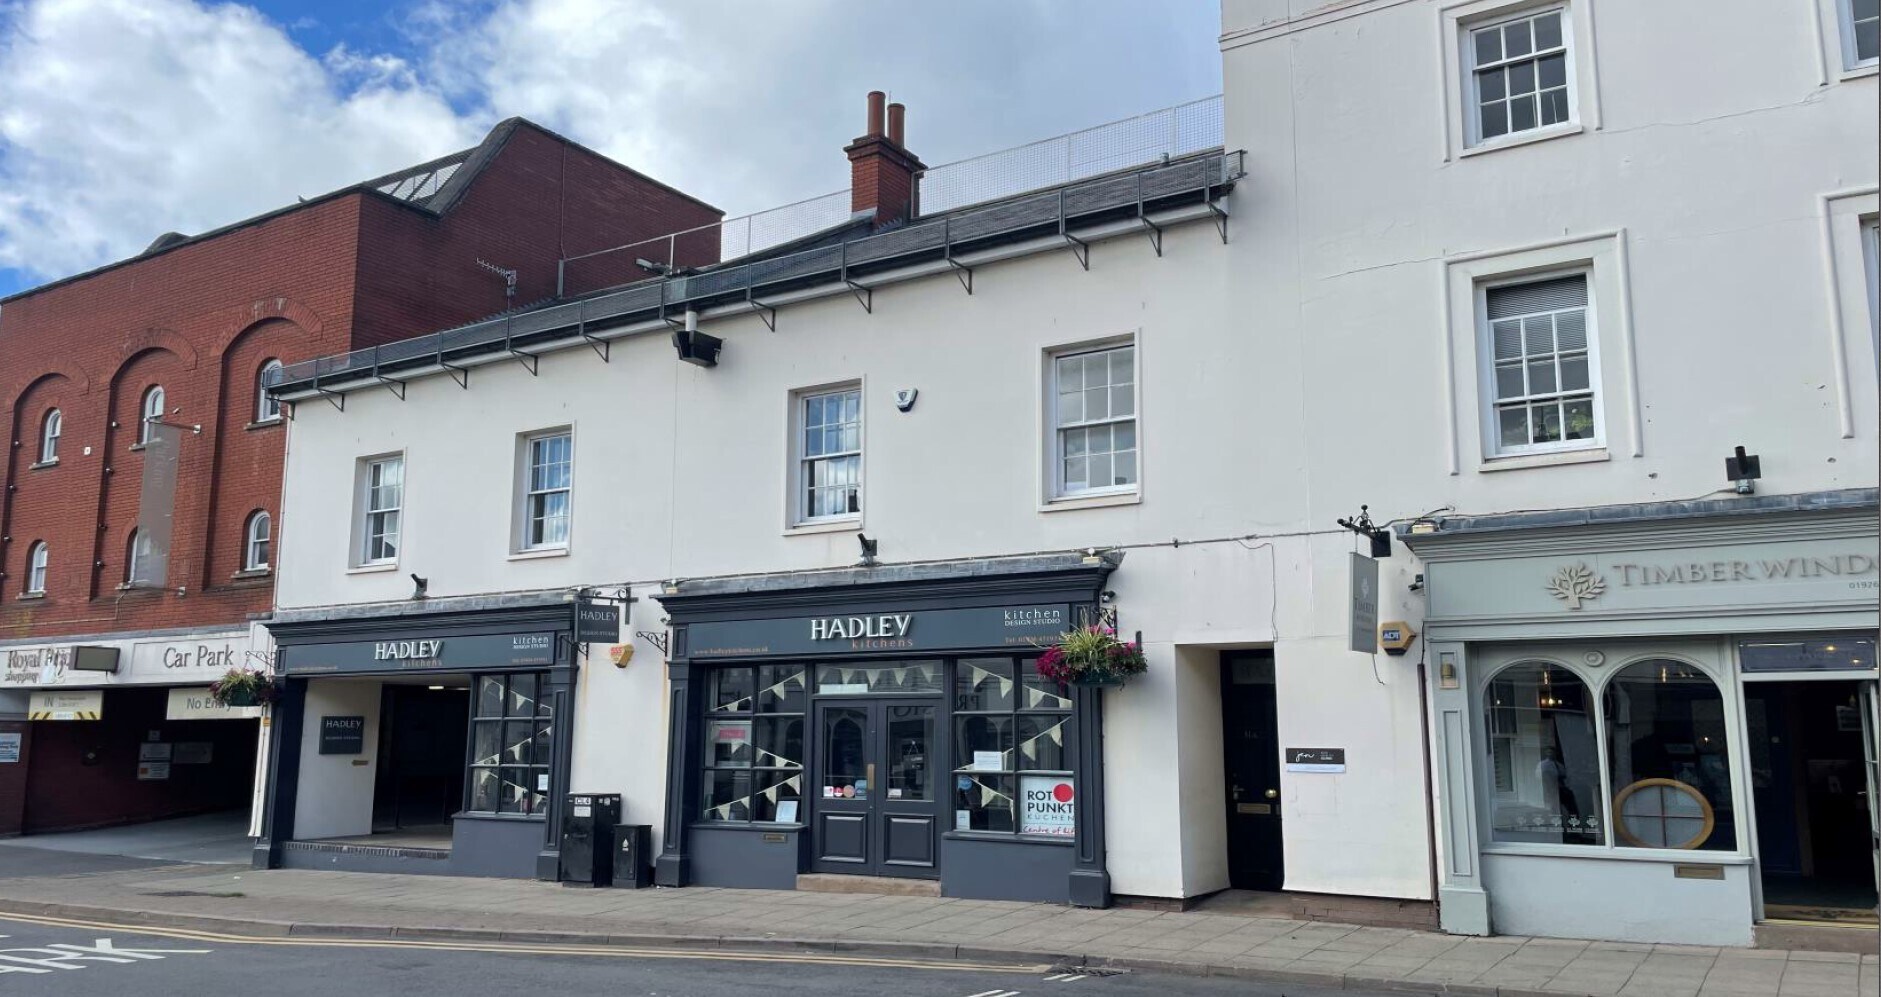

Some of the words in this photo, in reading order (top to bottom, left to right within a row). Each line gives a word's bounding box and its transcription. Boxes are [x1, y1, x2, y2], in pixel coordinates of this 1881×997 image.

[580, 610, 618, 621] HADLEY
[1004, 608, 1060, 620] kitchen
[810, 614, 911, 640] HADLEY
[513, 635, 549, 644] kitchen
[852, 638, 914, 650] kitchens
[163, 647, 192, 669] Car
[196, 644, 234, 667] Park
[374, 641, 442, 660] HADLEY
[8, 649, 43, 671] Royal
[402, 660, 442, 668] kitchens
[186, 697, 202, 709] No
[326, 719, 361, 729] HADLEY
[1027, 790, 1053, 801] ROT
[1027, 802, 1073, 813] PUNKT
